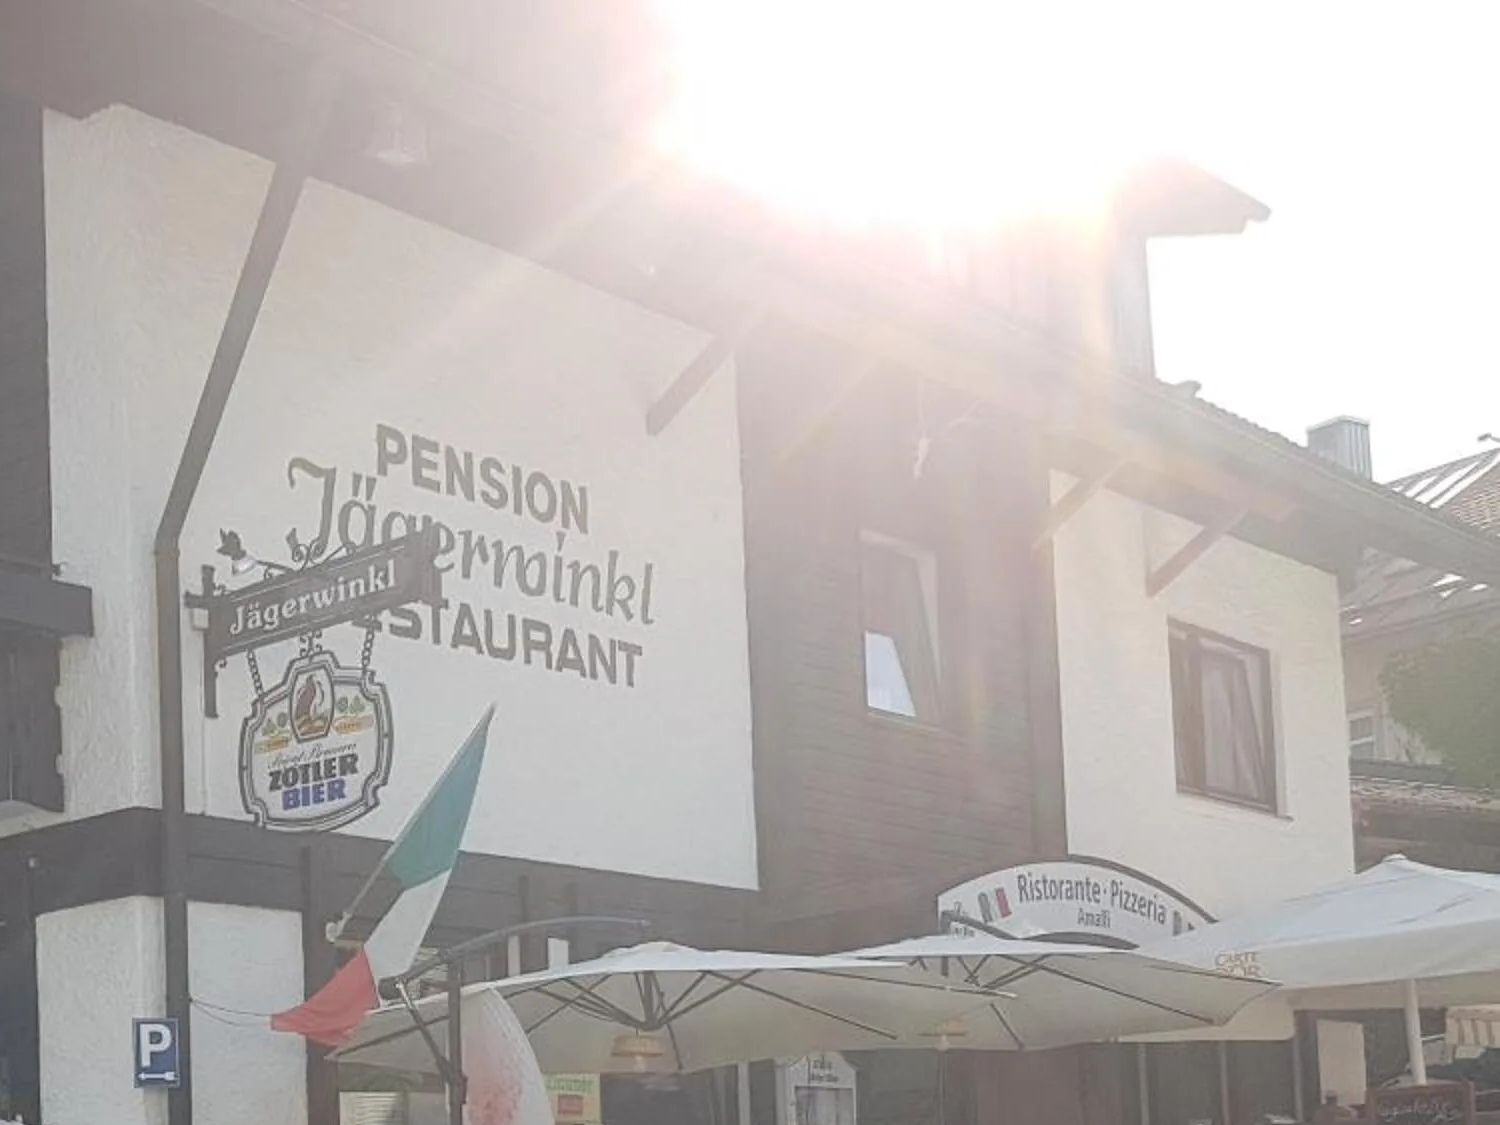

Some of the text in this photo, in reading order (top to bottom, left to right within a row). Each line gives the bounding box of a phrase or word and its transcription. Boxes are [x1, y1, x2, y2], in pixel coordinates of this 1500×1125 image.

[376, 423, 589, 535] PENSION
[230, 559, 397, 635] Jägerwinkl
[282, 779, 346, 811] BIER
[1017, 872, 1166, 925] Ristorante Pizzeria
[140, 1023, 172, 1068] P
